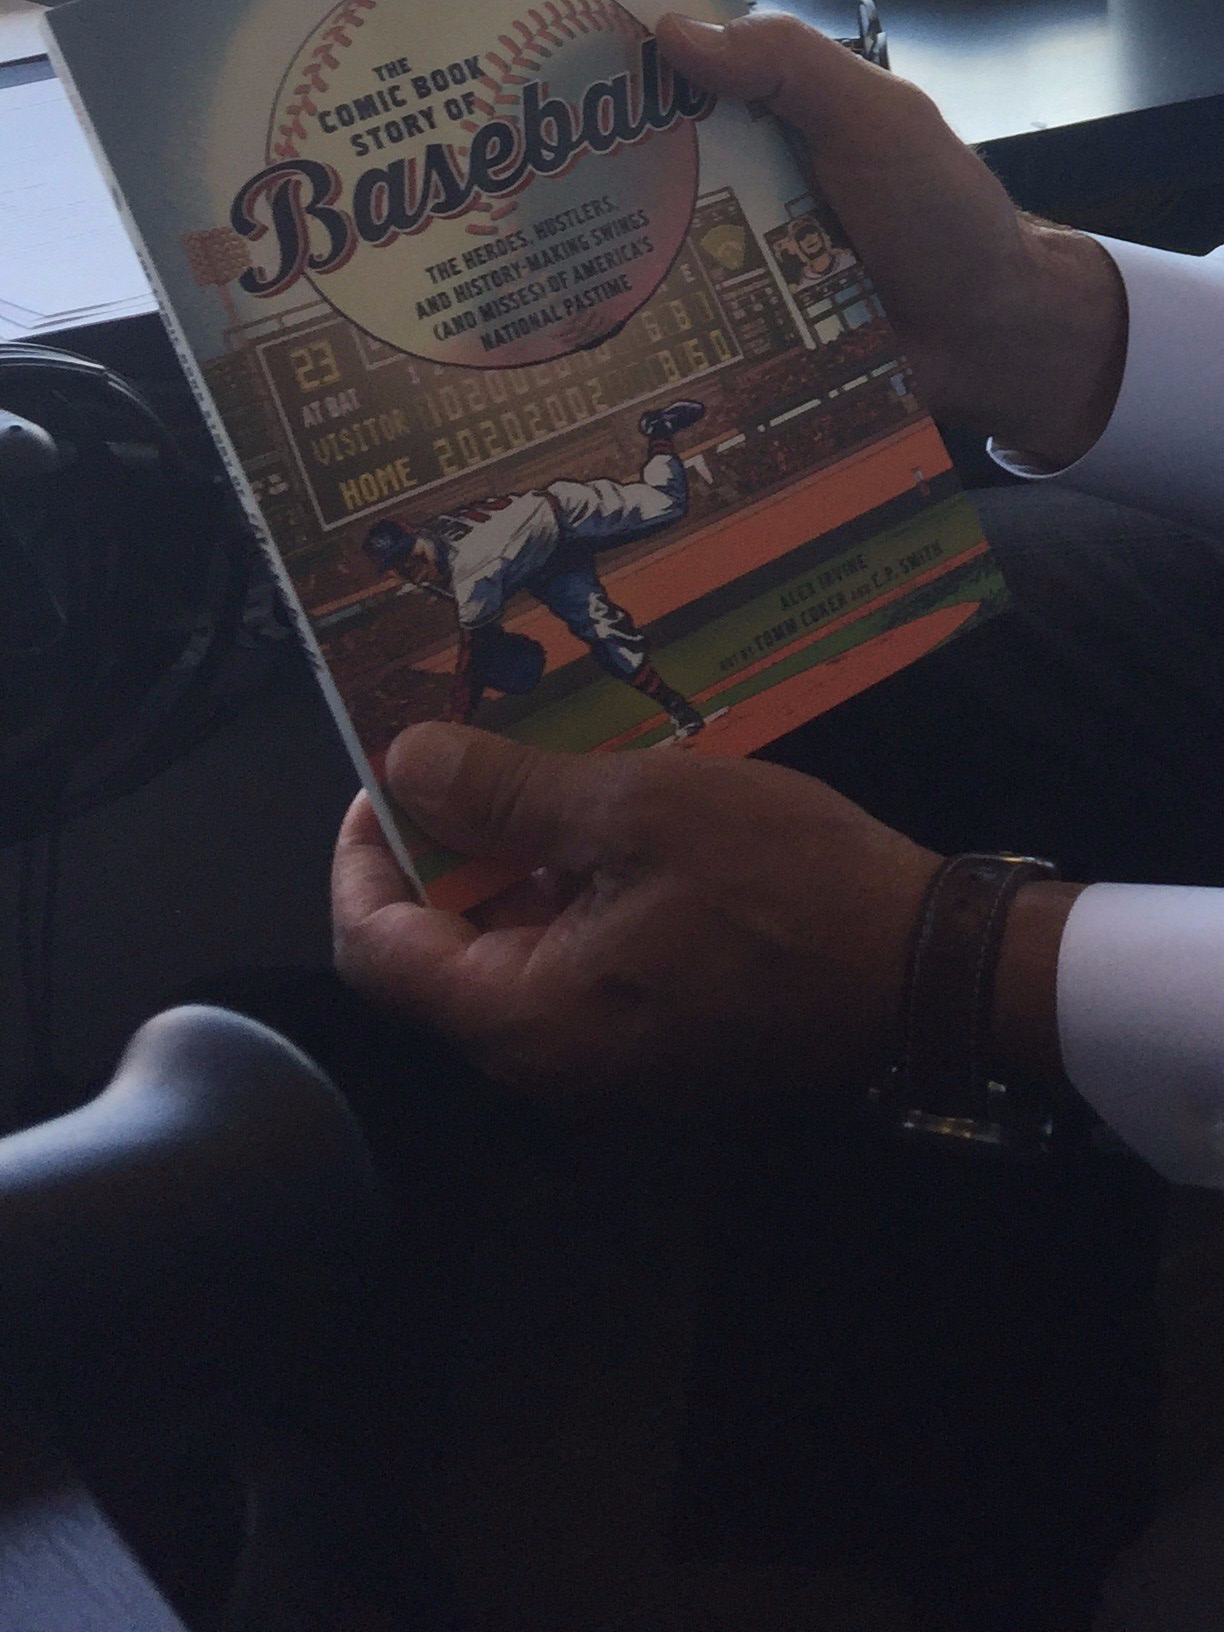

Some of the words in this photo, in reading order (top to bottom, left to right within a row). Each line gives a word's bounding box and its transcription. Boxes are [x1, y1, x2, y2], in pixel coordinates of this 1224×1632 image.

[317, 85, 407, 135] COMIC
[410, 54, 485, 100] BOOK
[372, 57, 410, 82] THE
[350, 114, 438, 158] STORY
[444, 91, 477, 123] OF
[230, 37, 716, 297] Baseball
[415, 292, 452, 320] AND
[453, 234, 590, 304] HISTORY-MAKING
[592, 210, 650, 247] SWINGS
[426, 257, 462, 285] THE
[463, 229, 535, 269] HEROES,
[433, 310, 478, 342] (AND
[478, 280, 547, 323] MISSES)
[547, 271, 568, 294] OF
[573, 236, 655, 282] AMERICA'S
[480, 303, 562, 352] NATIONAL
[563, 274, 633, 317] PASTIME
[289, 339, 342, 393] 23
[302, 400, 325, 429] AT
[311, 409, 410, 466] VISITOR
[338, 456, 418, 510] HOME
[780, 581, 816, 611] ALEX
[817, 553, 868, 589] IRVINE
[800, 591, 848, 628] COKER
[899, 539, 944, 575] SMITH
